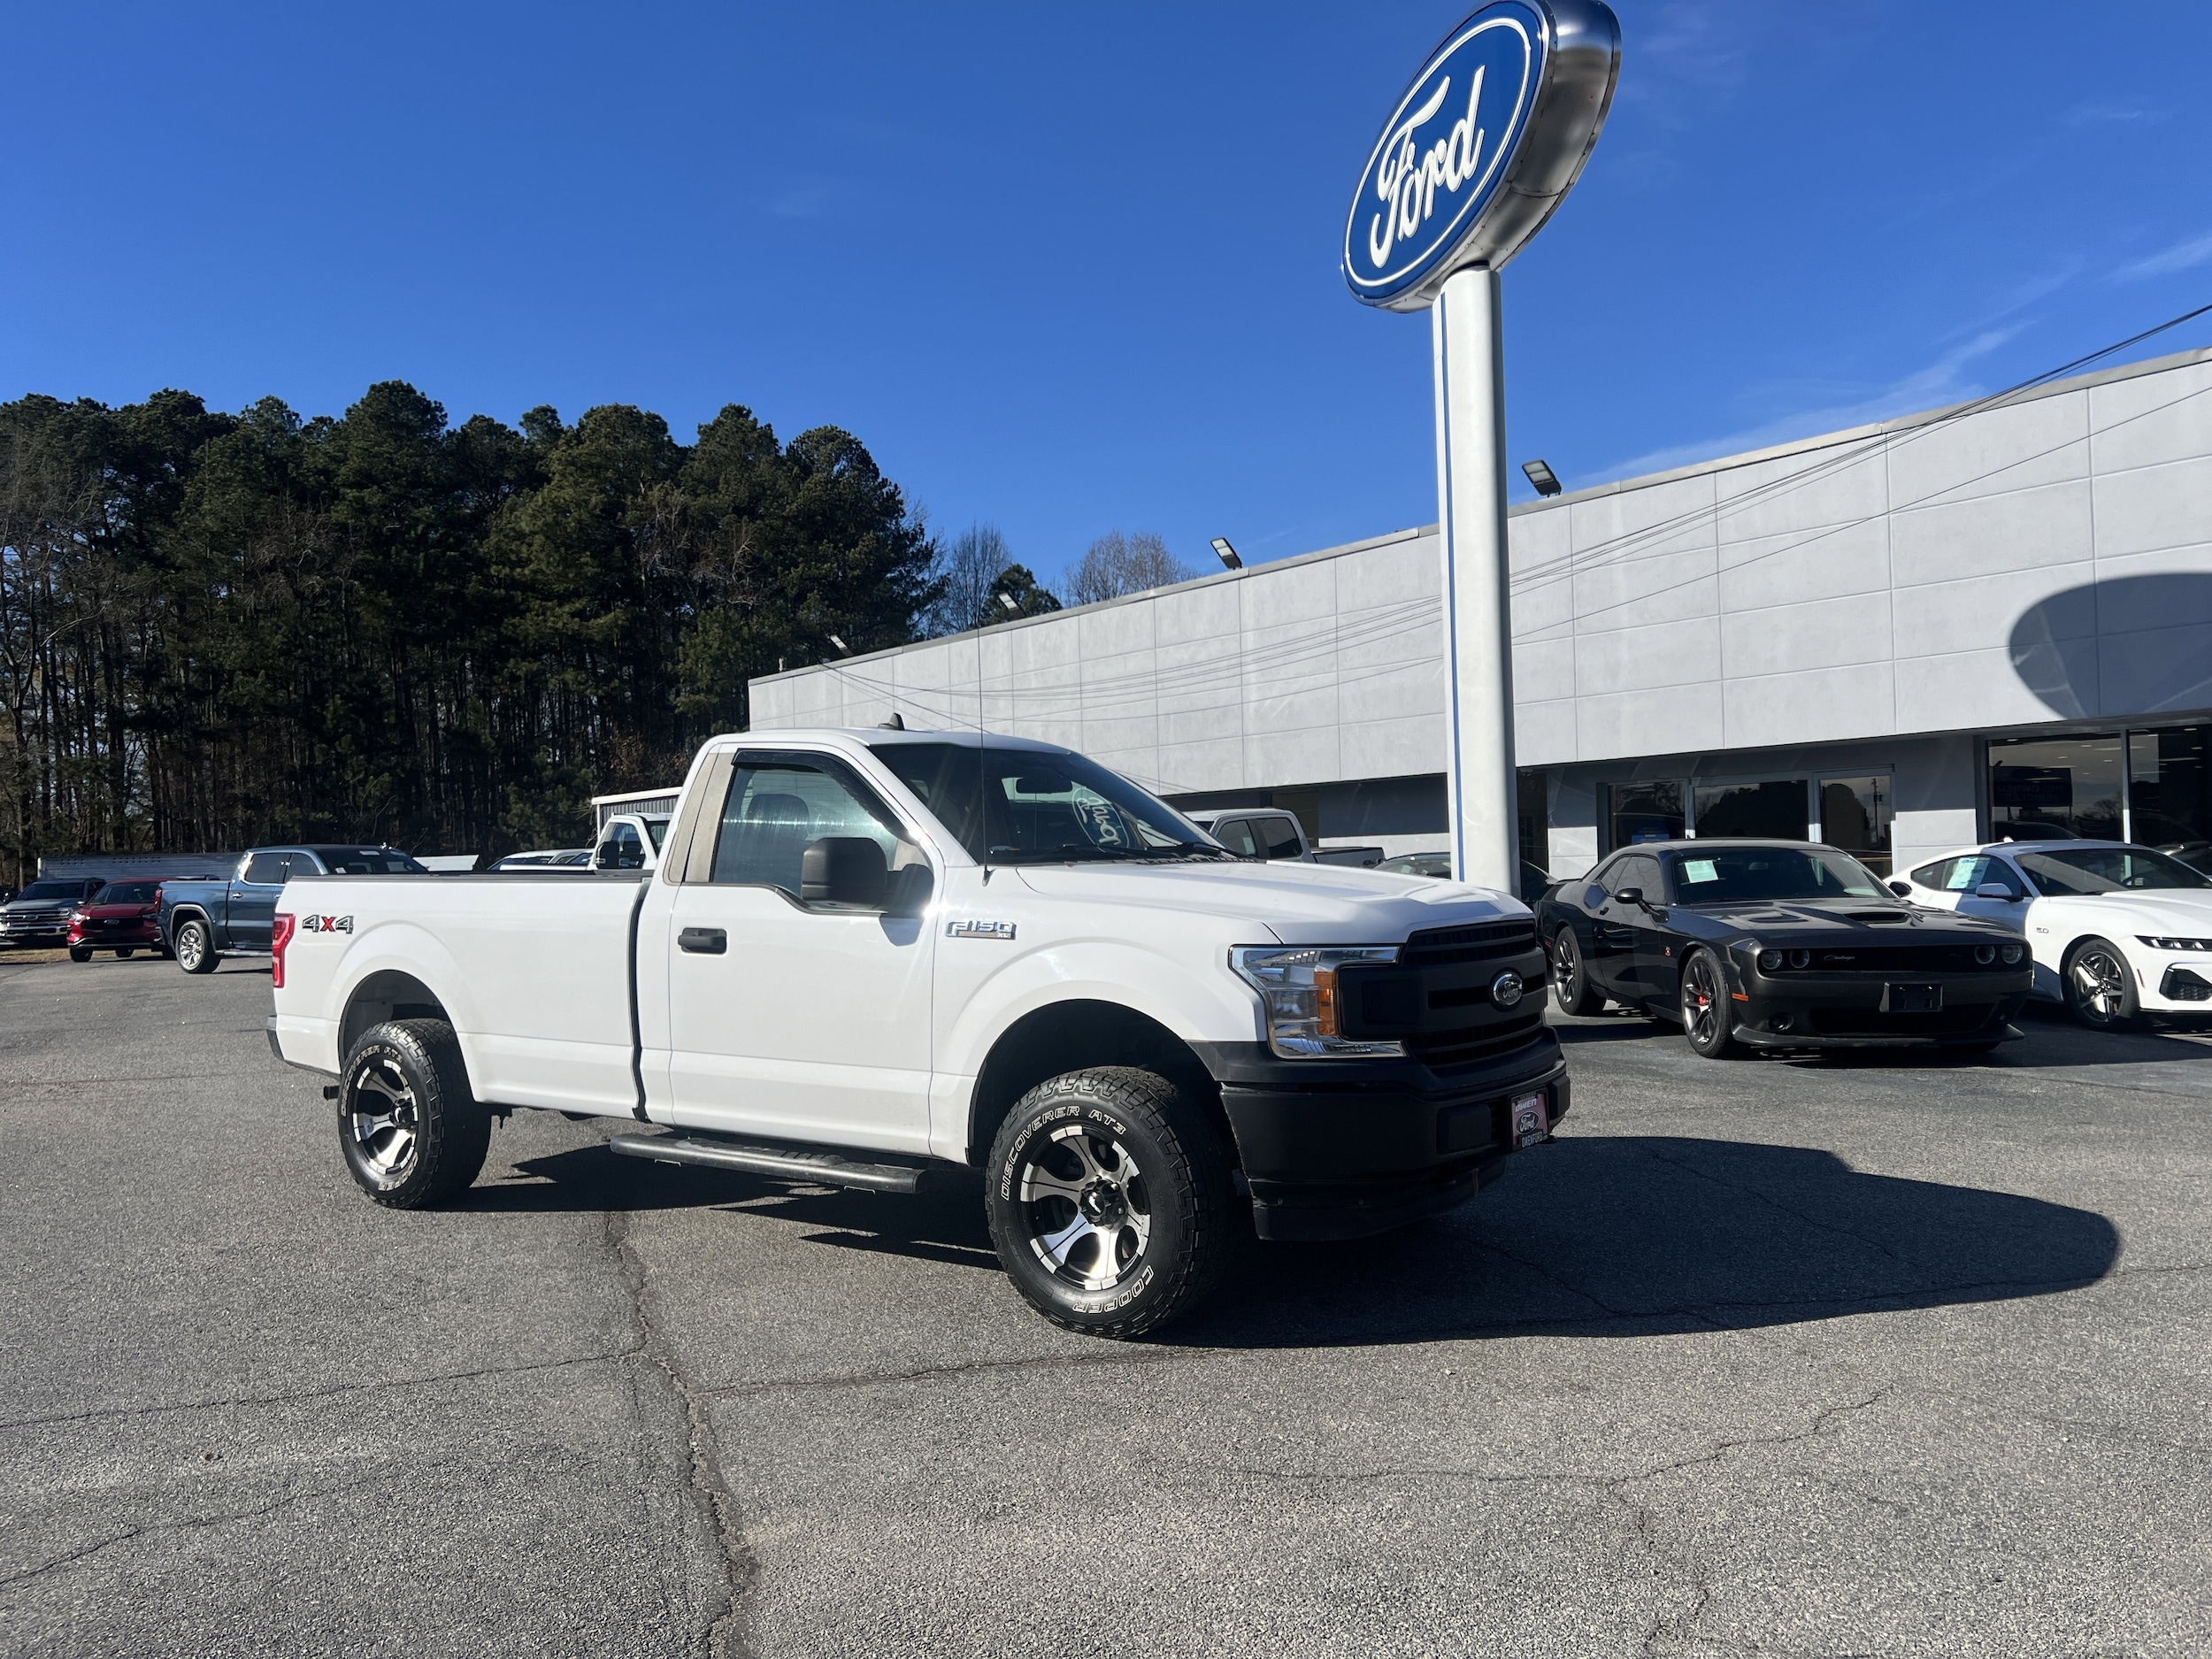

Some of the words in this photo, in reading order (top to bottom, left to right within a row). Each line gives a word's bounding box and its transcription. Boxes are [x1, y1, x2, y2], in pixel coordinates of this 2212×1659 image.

[1370, 65, 1485, 268] Ford
[341, 1044, 380, 1117] DISCOVERER
[1001, 1105, 1080, 1201] DISCOVERER
[1088, 1110, 1127, 1135] AT3
[1519, 1113, 1535, 1133] Ford
[1072, 1265, 1155, 1313] COOPER
